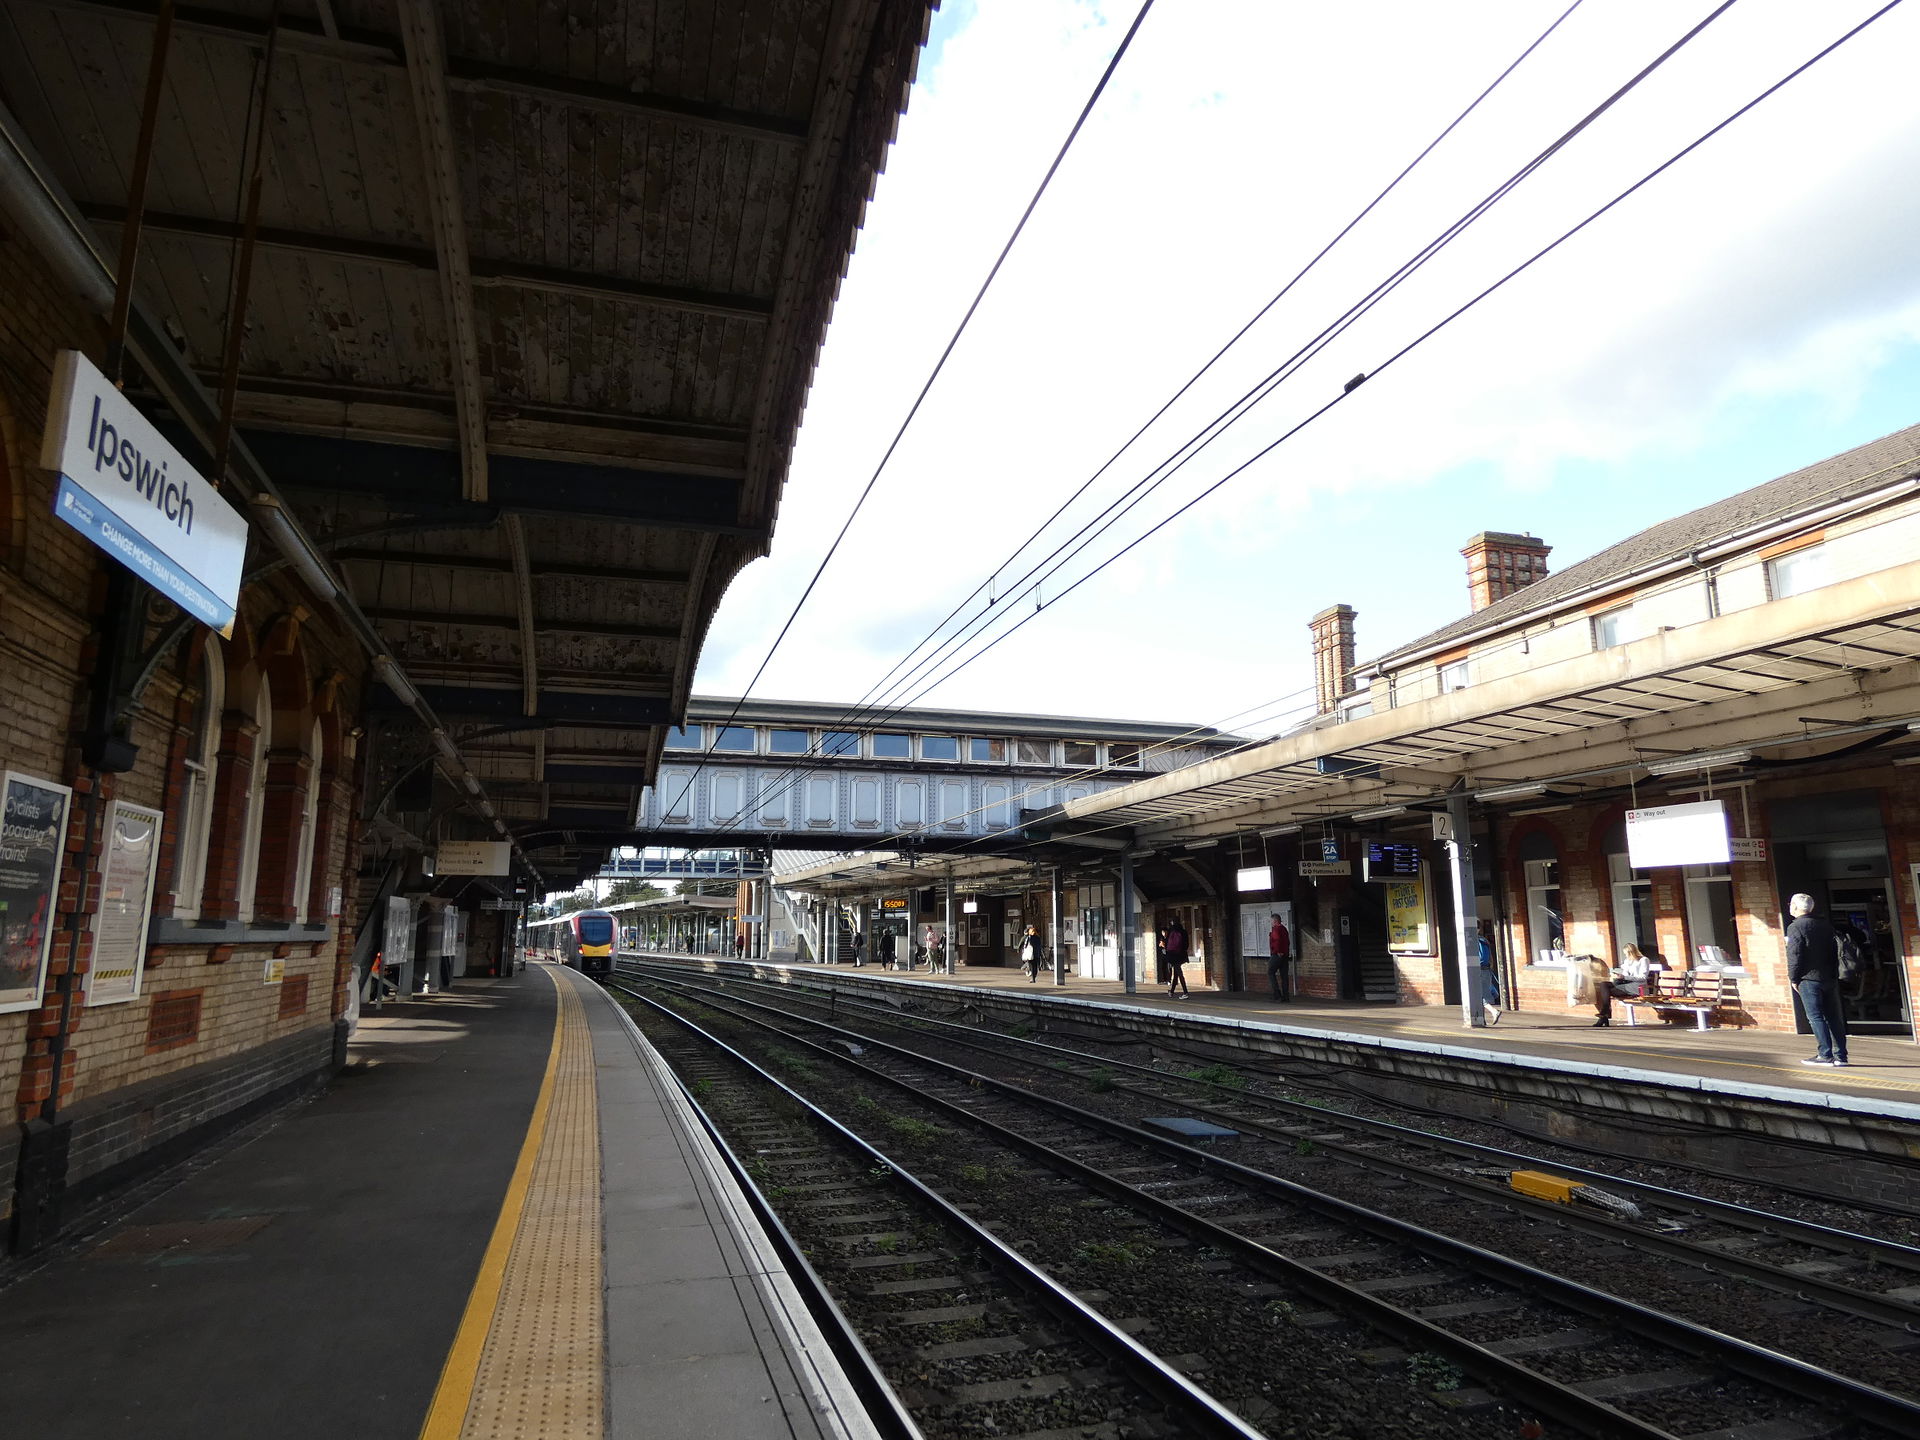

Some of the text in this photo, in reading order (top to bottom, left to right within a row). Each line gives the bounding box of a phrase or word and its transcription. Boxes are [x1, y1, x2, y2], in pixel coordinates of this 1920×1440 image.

[88, 394, 193, 536] Ipswich
[102, 522, 134, 556] CHANGE
[132, 544, 153, 570] MORE
[152, 559, 170, 584] THAN
[169, 572, 185, 595] YOUR
[6, 796, 41, 819] Cyclists
[2, 819, 46, 847] boarding
[1438, 816, 1446, 835] 2
[1323, 845, 1337, 854] 2A
